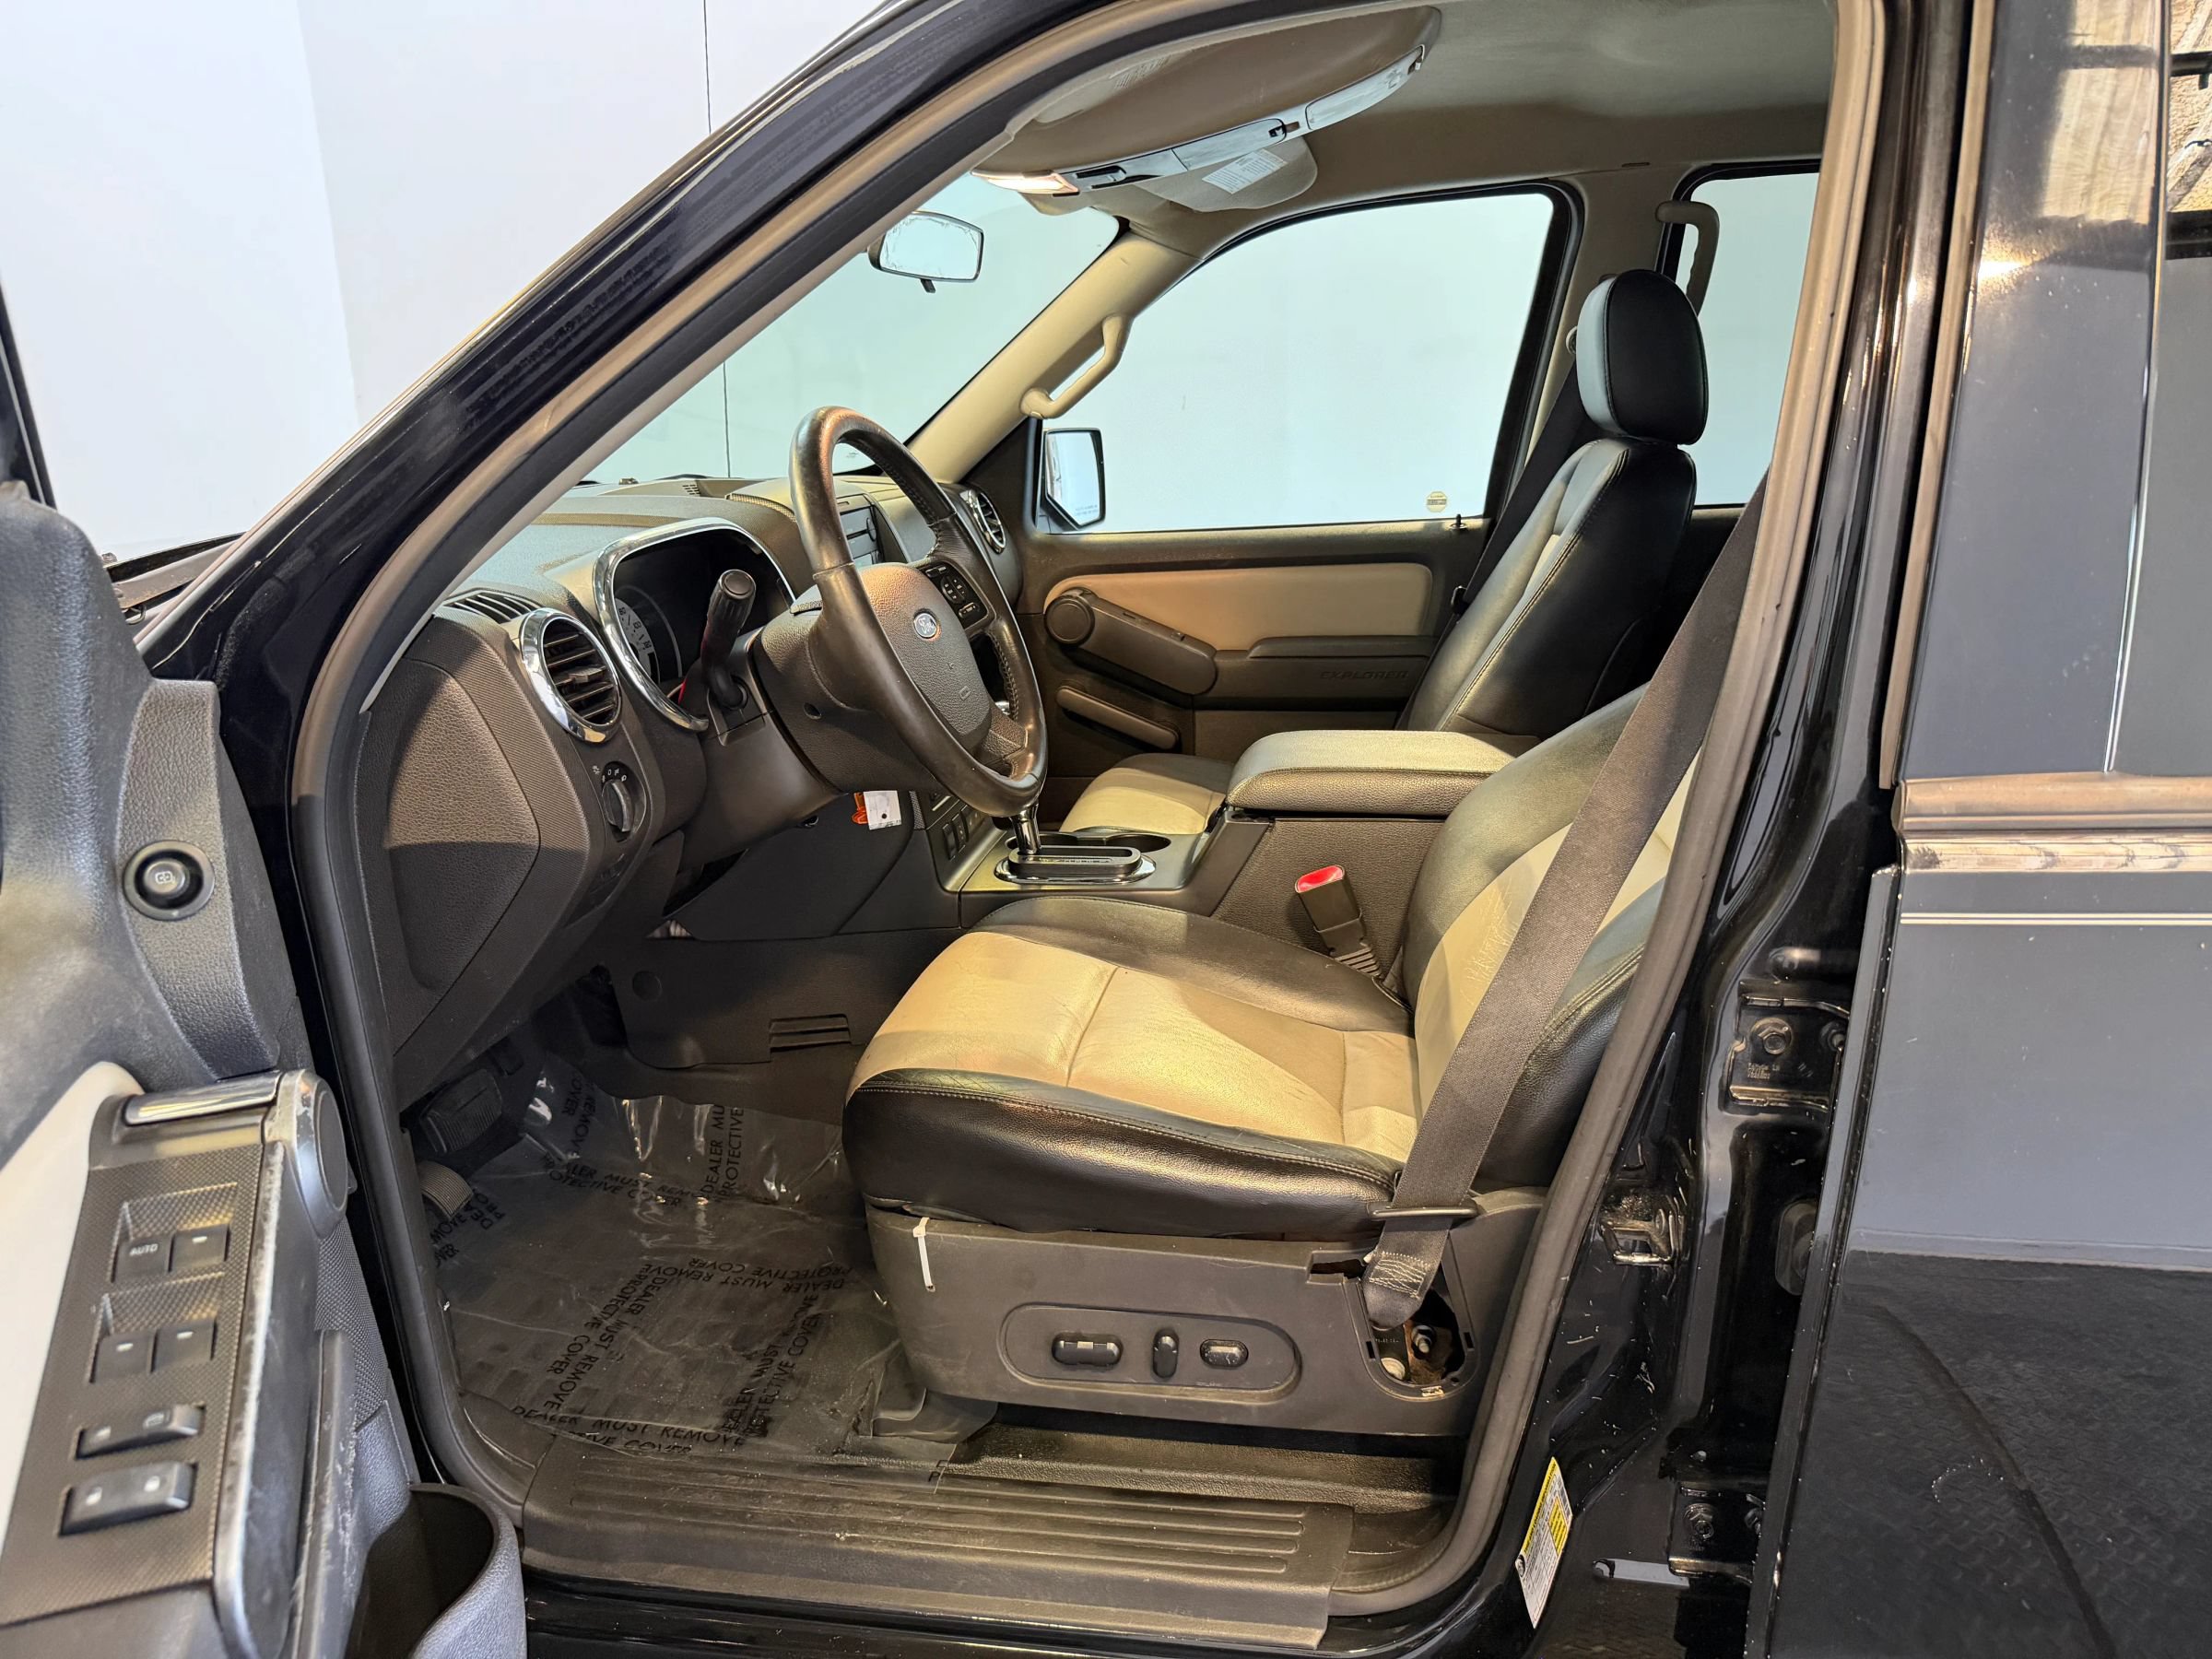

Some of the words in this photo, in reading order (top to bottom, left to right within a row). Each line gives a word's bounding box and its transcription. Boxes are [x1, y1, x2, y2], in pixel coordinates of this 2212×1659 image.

[1319, 670, 1409, 680] EXPLORER
[719, 1108, 745, 1198] PROTECTIVE
[605, 1171, 650, 1188] MUST
[700, 1138, 723, 1200] DEALER
[129, 1242, 159, 1256] AUTO
[644, 1264, 714, 1282] REMOVE
[688, 1258, 746, 1272] COVER
[624, 1277, 668, 1315] DEALER
[720, 1276, 773, 1288] MUST
[782, 1277, 845, 1293] DEALER
[594, 1319, 629, 1350] MUST
[787, 1312, 823, 1357] COVER
[547, 1335, 590, 1374] COVER
[544, 1354, 599, 1410] REMOVE
[512, 1406, 579, 1426] DEALER
[593, 1418, 648, 1434] MUST
[660, 1425, 746, 1447] REMOVE
